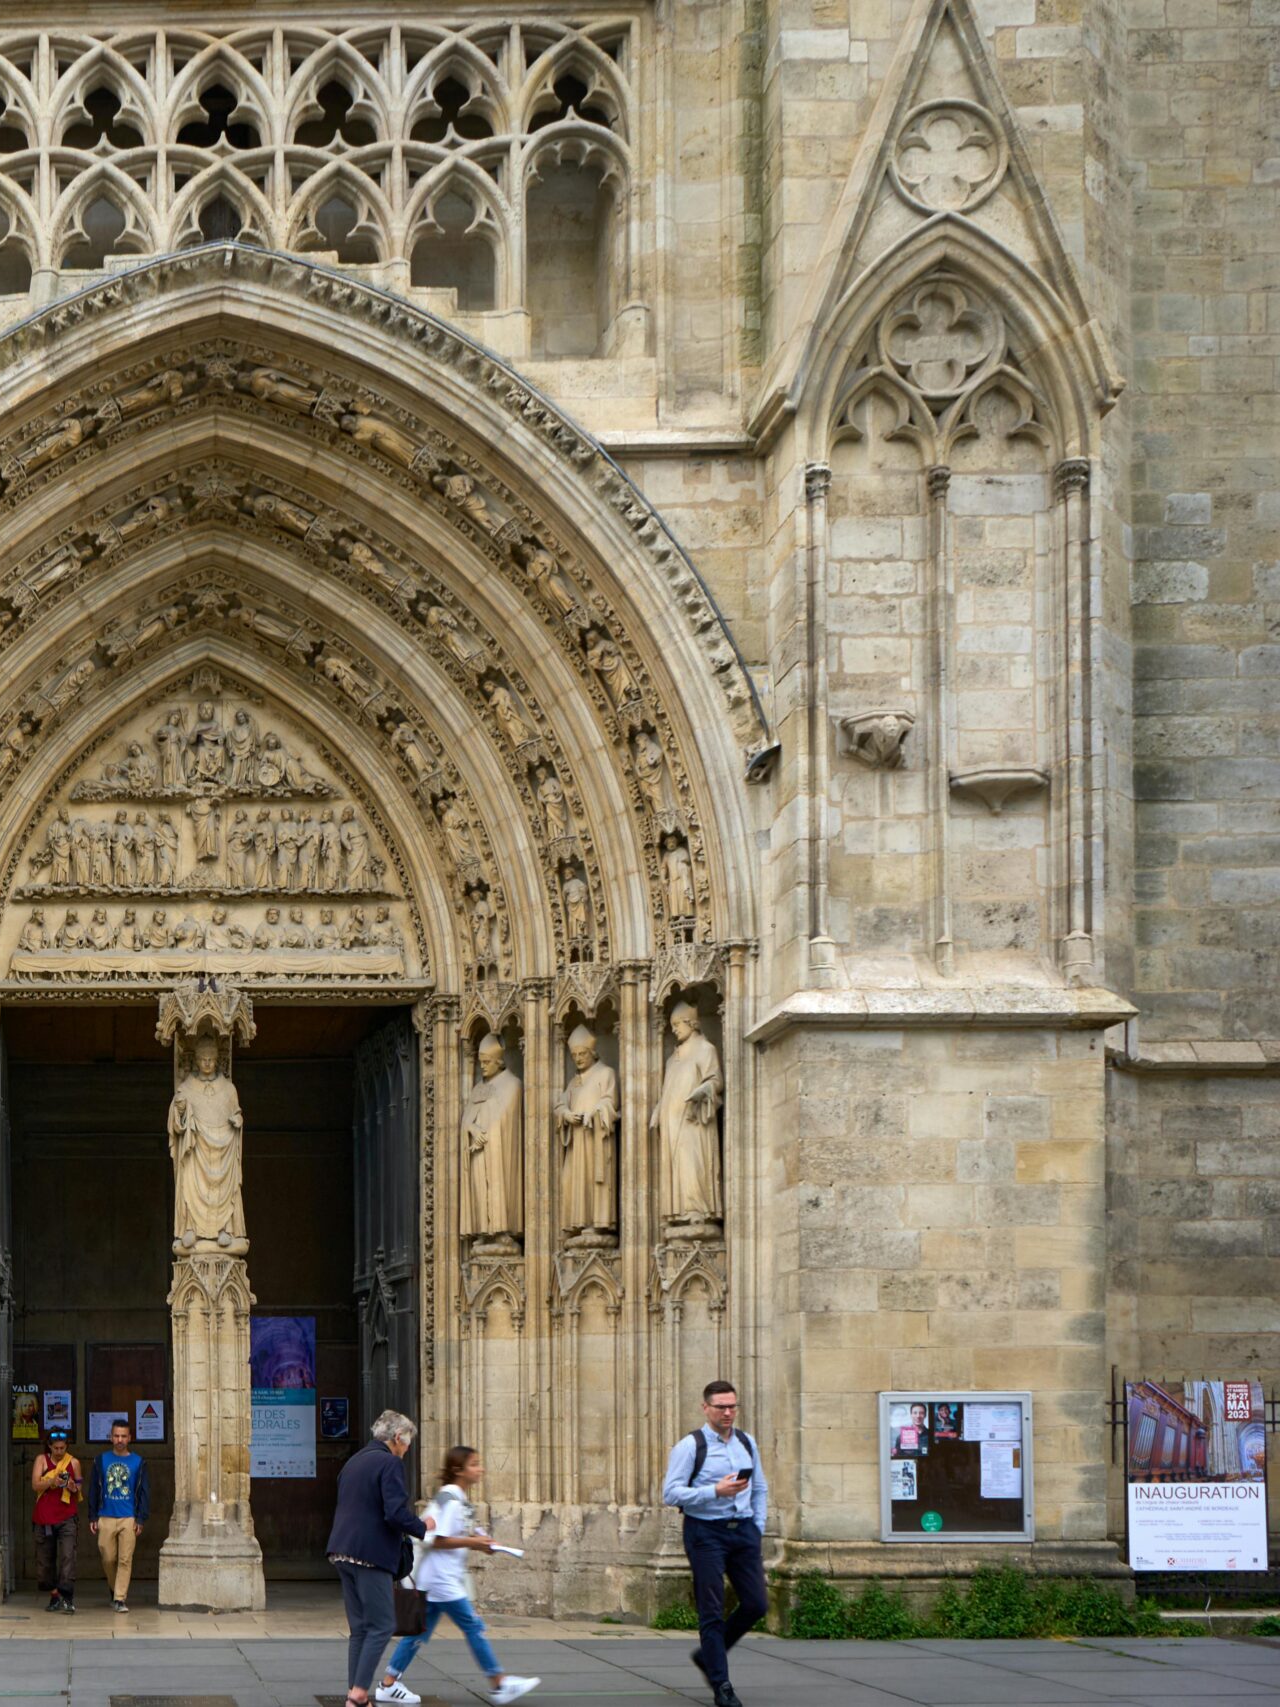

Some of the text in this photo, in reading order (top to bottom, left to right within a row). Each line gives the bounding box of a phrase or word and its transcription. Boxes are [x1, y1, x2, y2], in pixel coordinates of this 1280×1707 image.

[1227, 1400, 1250, 1411] MAI
[264, 1409, 286, 1419] DES
[1227, 1410, 1250, 1419] 2023
[1135, 1486, 1259, 1499] INAUGURATION
